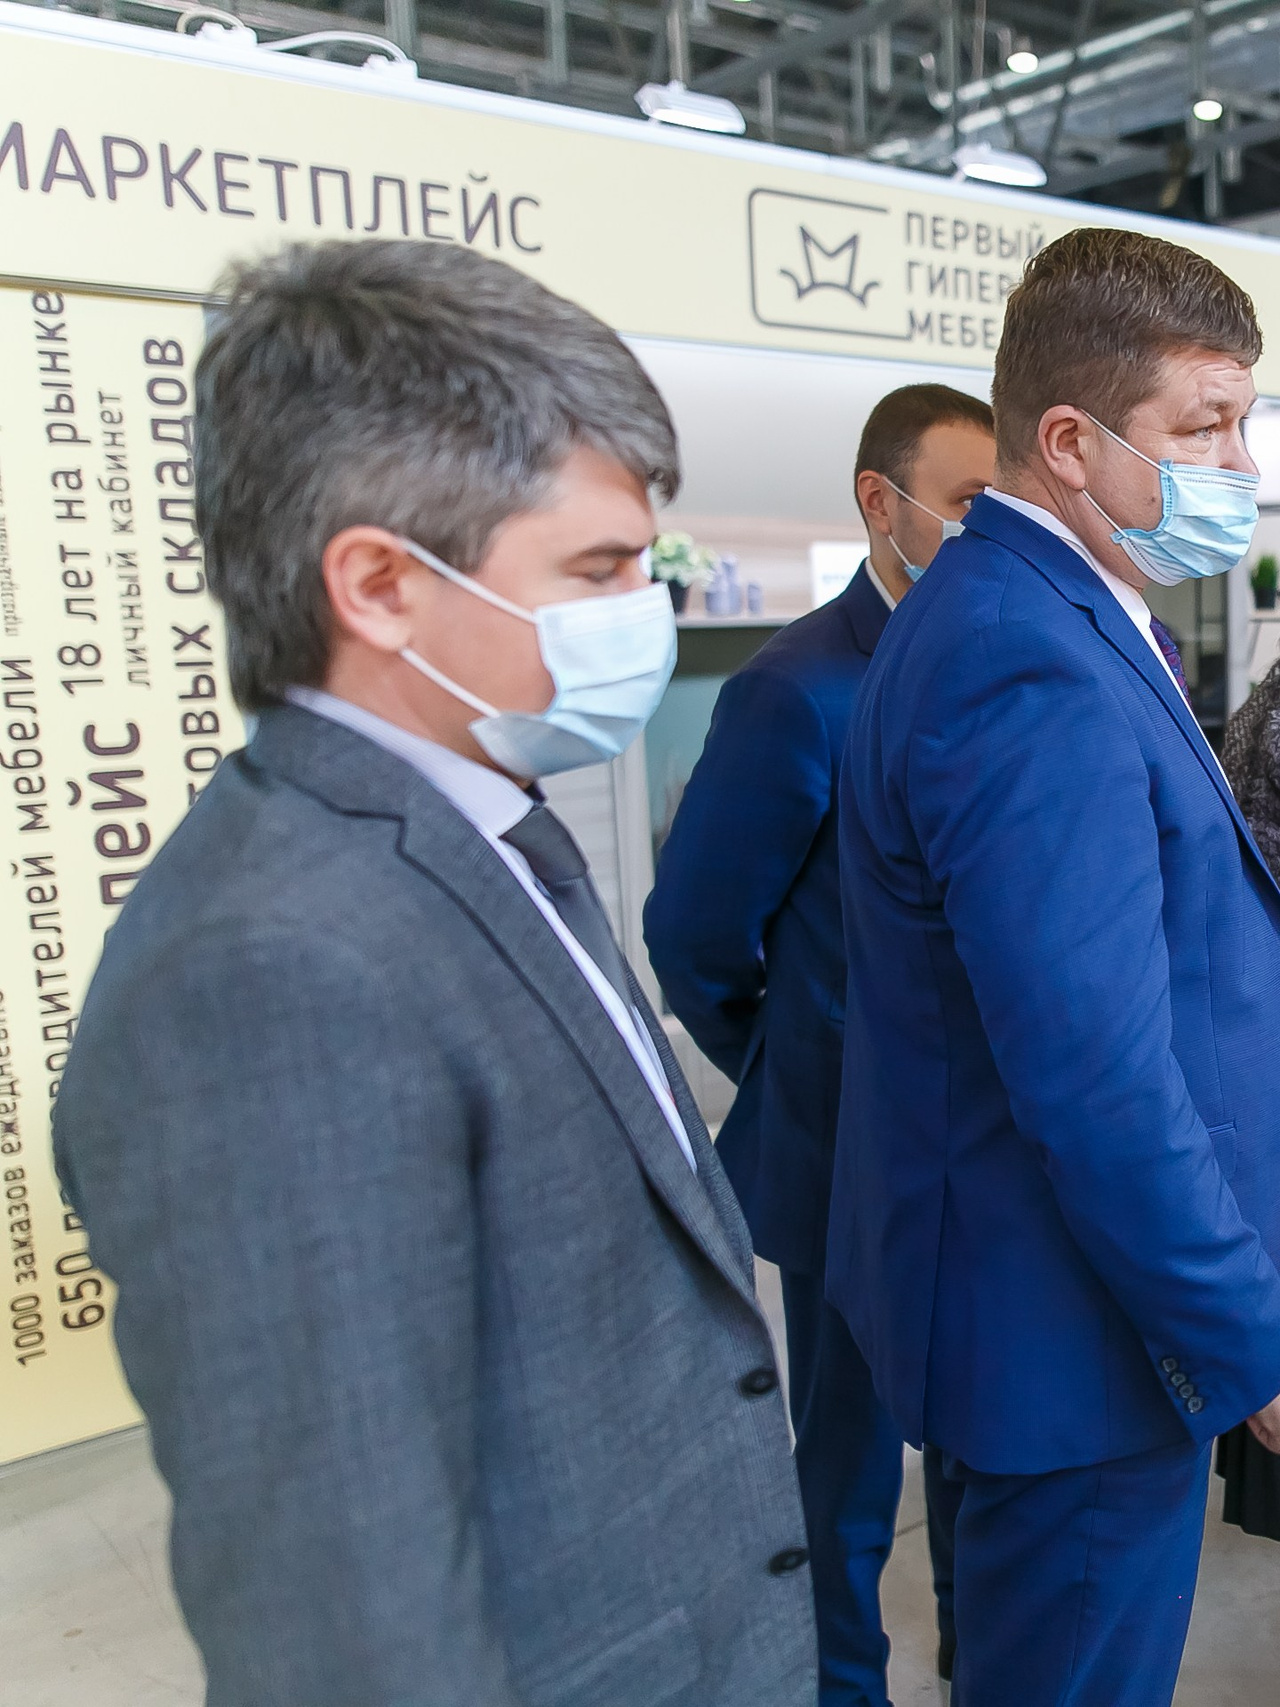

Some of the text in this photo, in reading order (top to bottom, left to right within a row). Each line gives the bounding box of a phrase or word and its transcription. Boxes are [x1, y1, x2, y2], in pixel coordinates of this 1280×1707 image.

[906, 211, 1045, 260] ПЕРВЫЙ
[33, 290, 104, 696] 18 лет на рынке
[98, 390, 151, 688] личный кабинет
[143, 338, 205, 595] складов
[0, 658, 106, 1333] 650 подителей мебели
[4, 1167, 39, 1286] заказов
[10, 1293, 48, 1368] 1000
